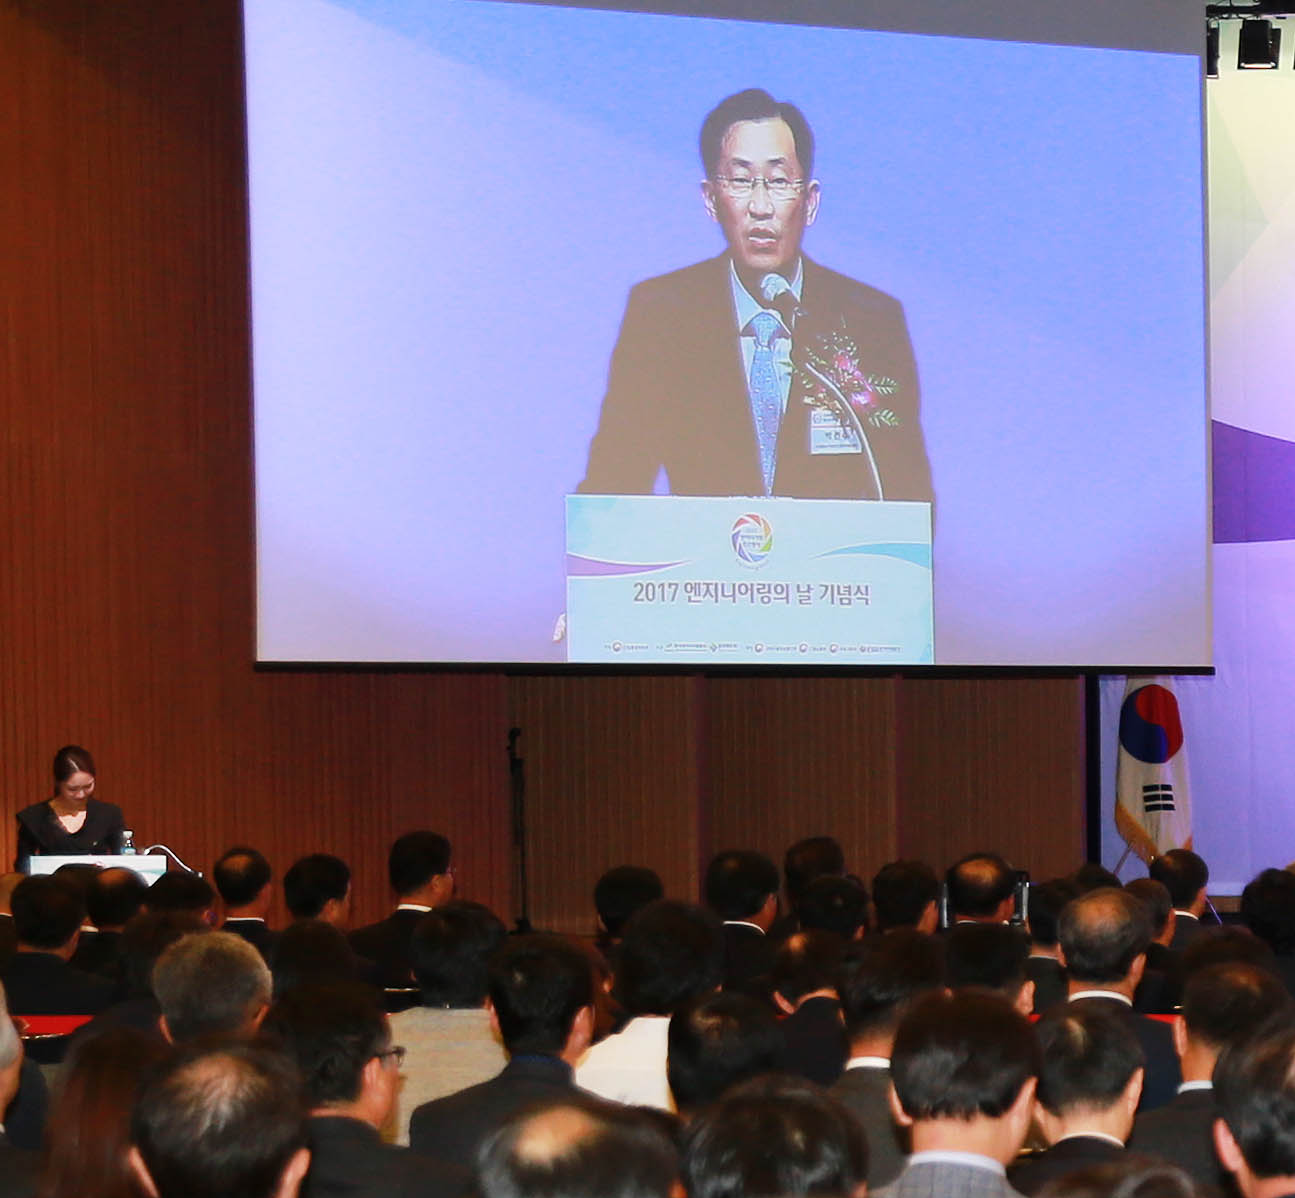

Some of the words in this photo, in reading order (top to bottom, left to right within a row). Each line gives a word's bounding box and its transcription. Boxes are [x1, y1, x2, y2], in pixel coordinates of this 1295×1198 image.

[633, 582, 680, 603] 2017
[684, 582, 791, 605] 엔지니어링의
[796, 583, 813, 606] 날
[819, 583, 871, 606] 기념식
